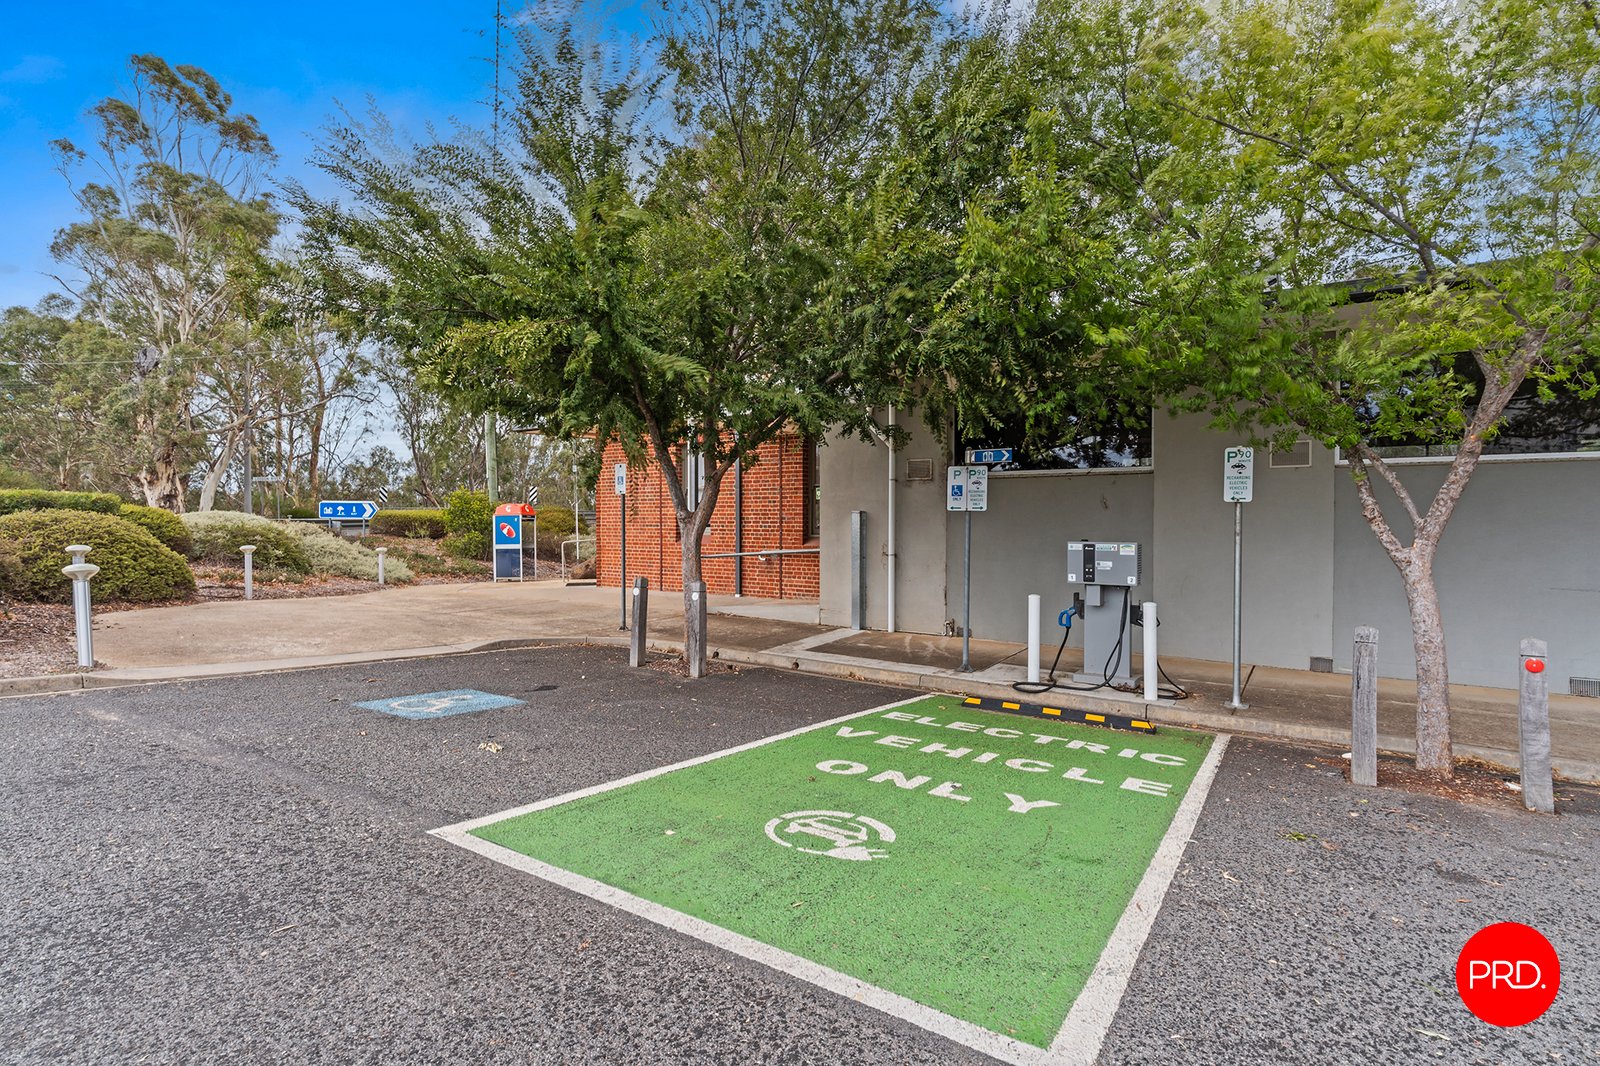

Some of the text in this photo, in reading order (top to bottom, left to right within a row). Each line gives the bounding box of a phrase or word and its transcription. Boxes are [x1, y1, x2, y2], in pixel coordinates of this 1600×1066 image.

[953, 470, 962, 480] P
[835, 726, 1173, 797] VEHICLE
[881, 711, 1188, 766] ELECTRIC
[814, 758, 1062, 815] ONLY
